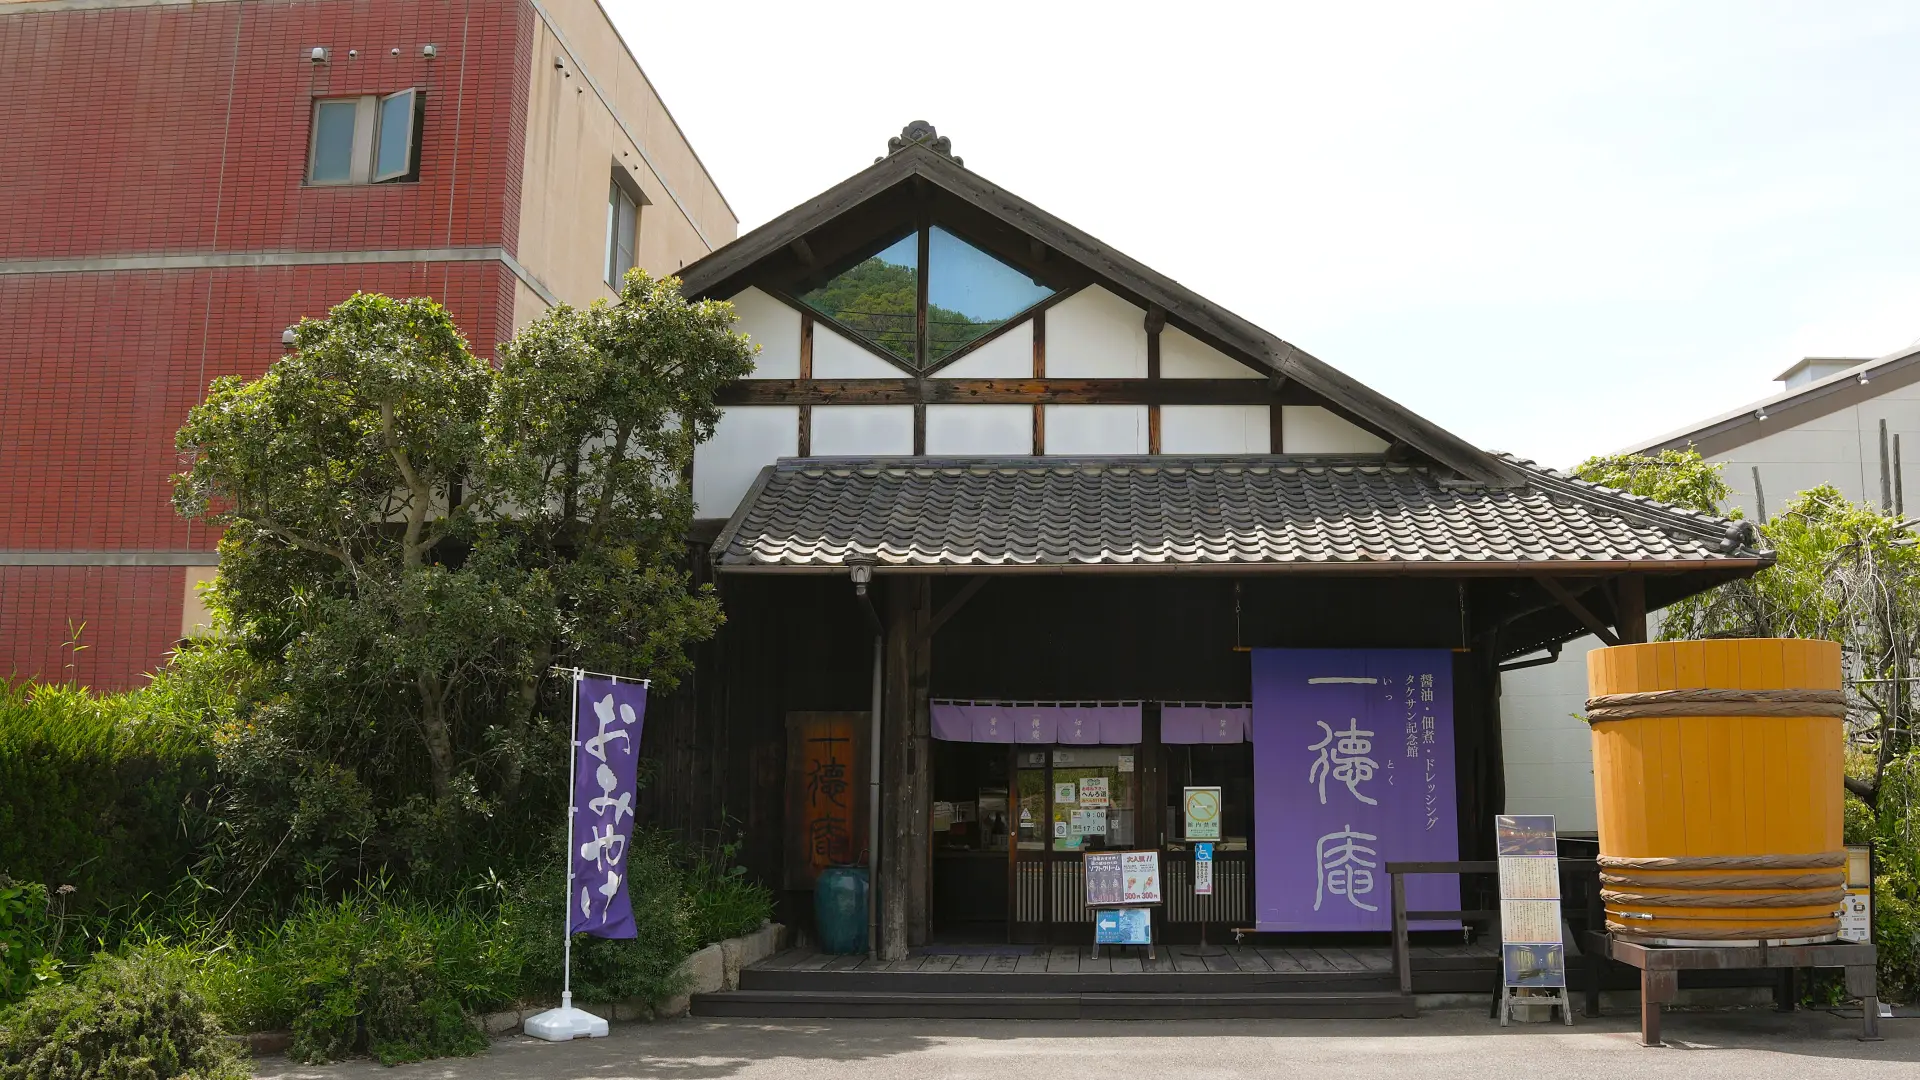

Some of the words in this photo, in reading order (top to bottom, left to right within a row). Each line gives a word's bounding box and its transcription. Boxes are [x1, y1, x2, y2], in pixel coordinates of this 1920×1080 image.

[1405, 674, 1419, 758] タケサン記念館
[1420, 673, 1439, 831] 醤油・佃煮・ドレッシング
[1086, 811, 1105, 819] 9:00
